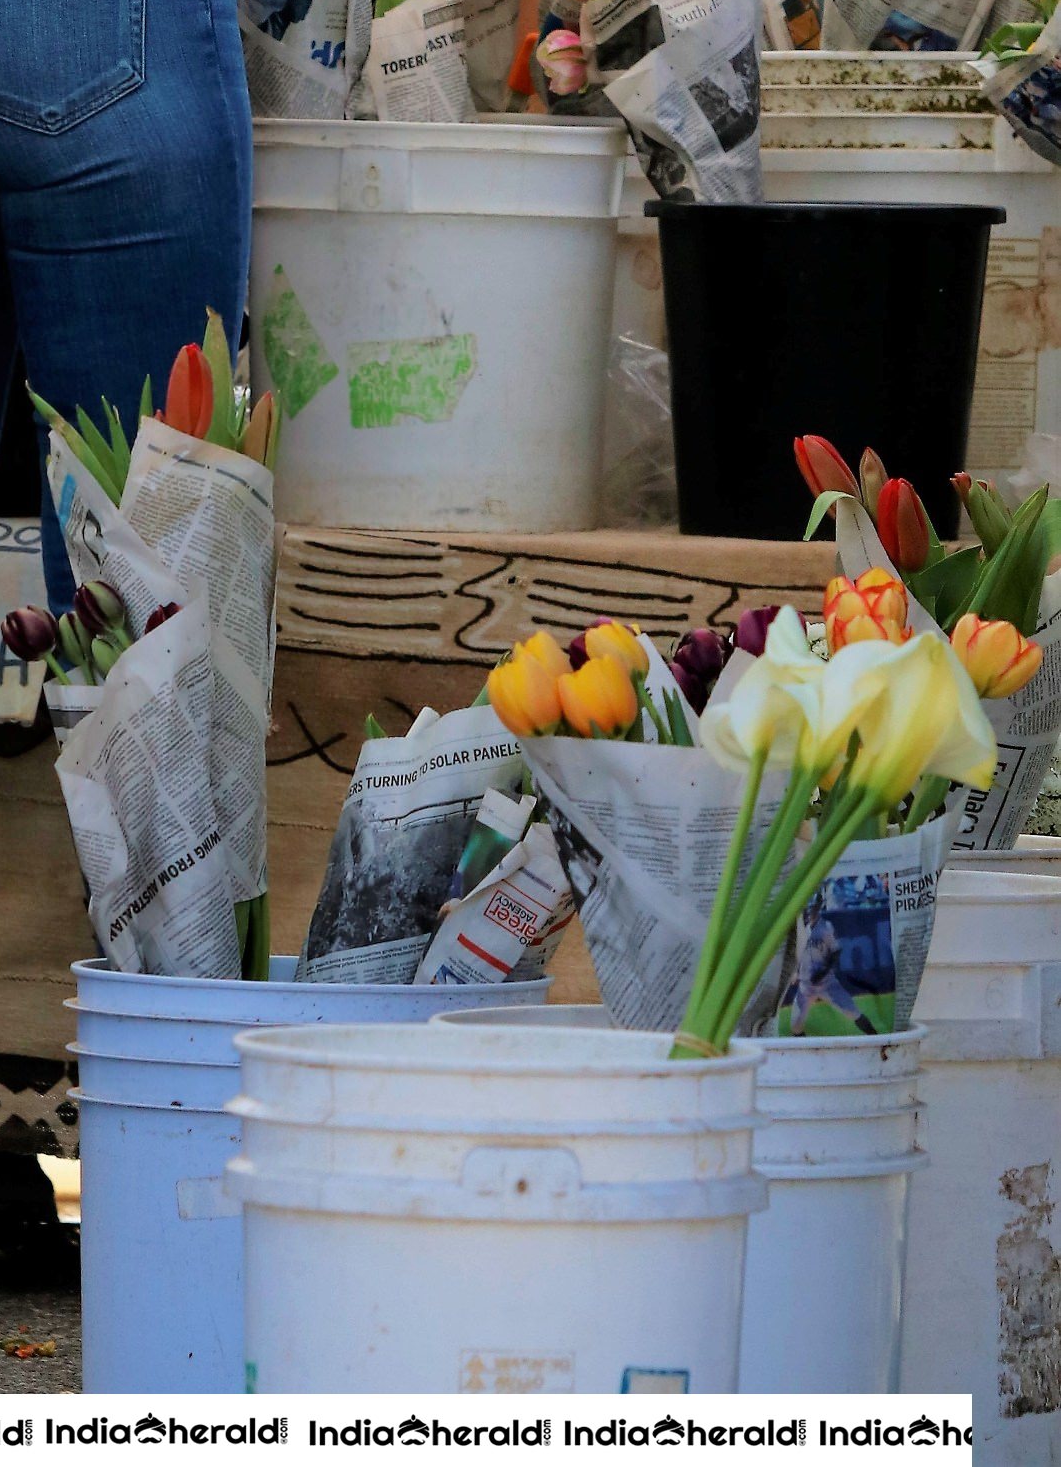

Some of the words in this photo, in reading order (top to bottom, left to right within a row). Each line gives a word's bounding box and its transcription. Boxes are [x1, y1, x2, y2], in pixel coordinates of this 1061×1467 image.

[366, 771, 417, 790] TURNING
[429, 750, 470, 771] SOLAR
[473, 741, 522, 762] PANELS
[157, 853, 196, 887] FROM
[495, 896, 532, 922] AGENCY
